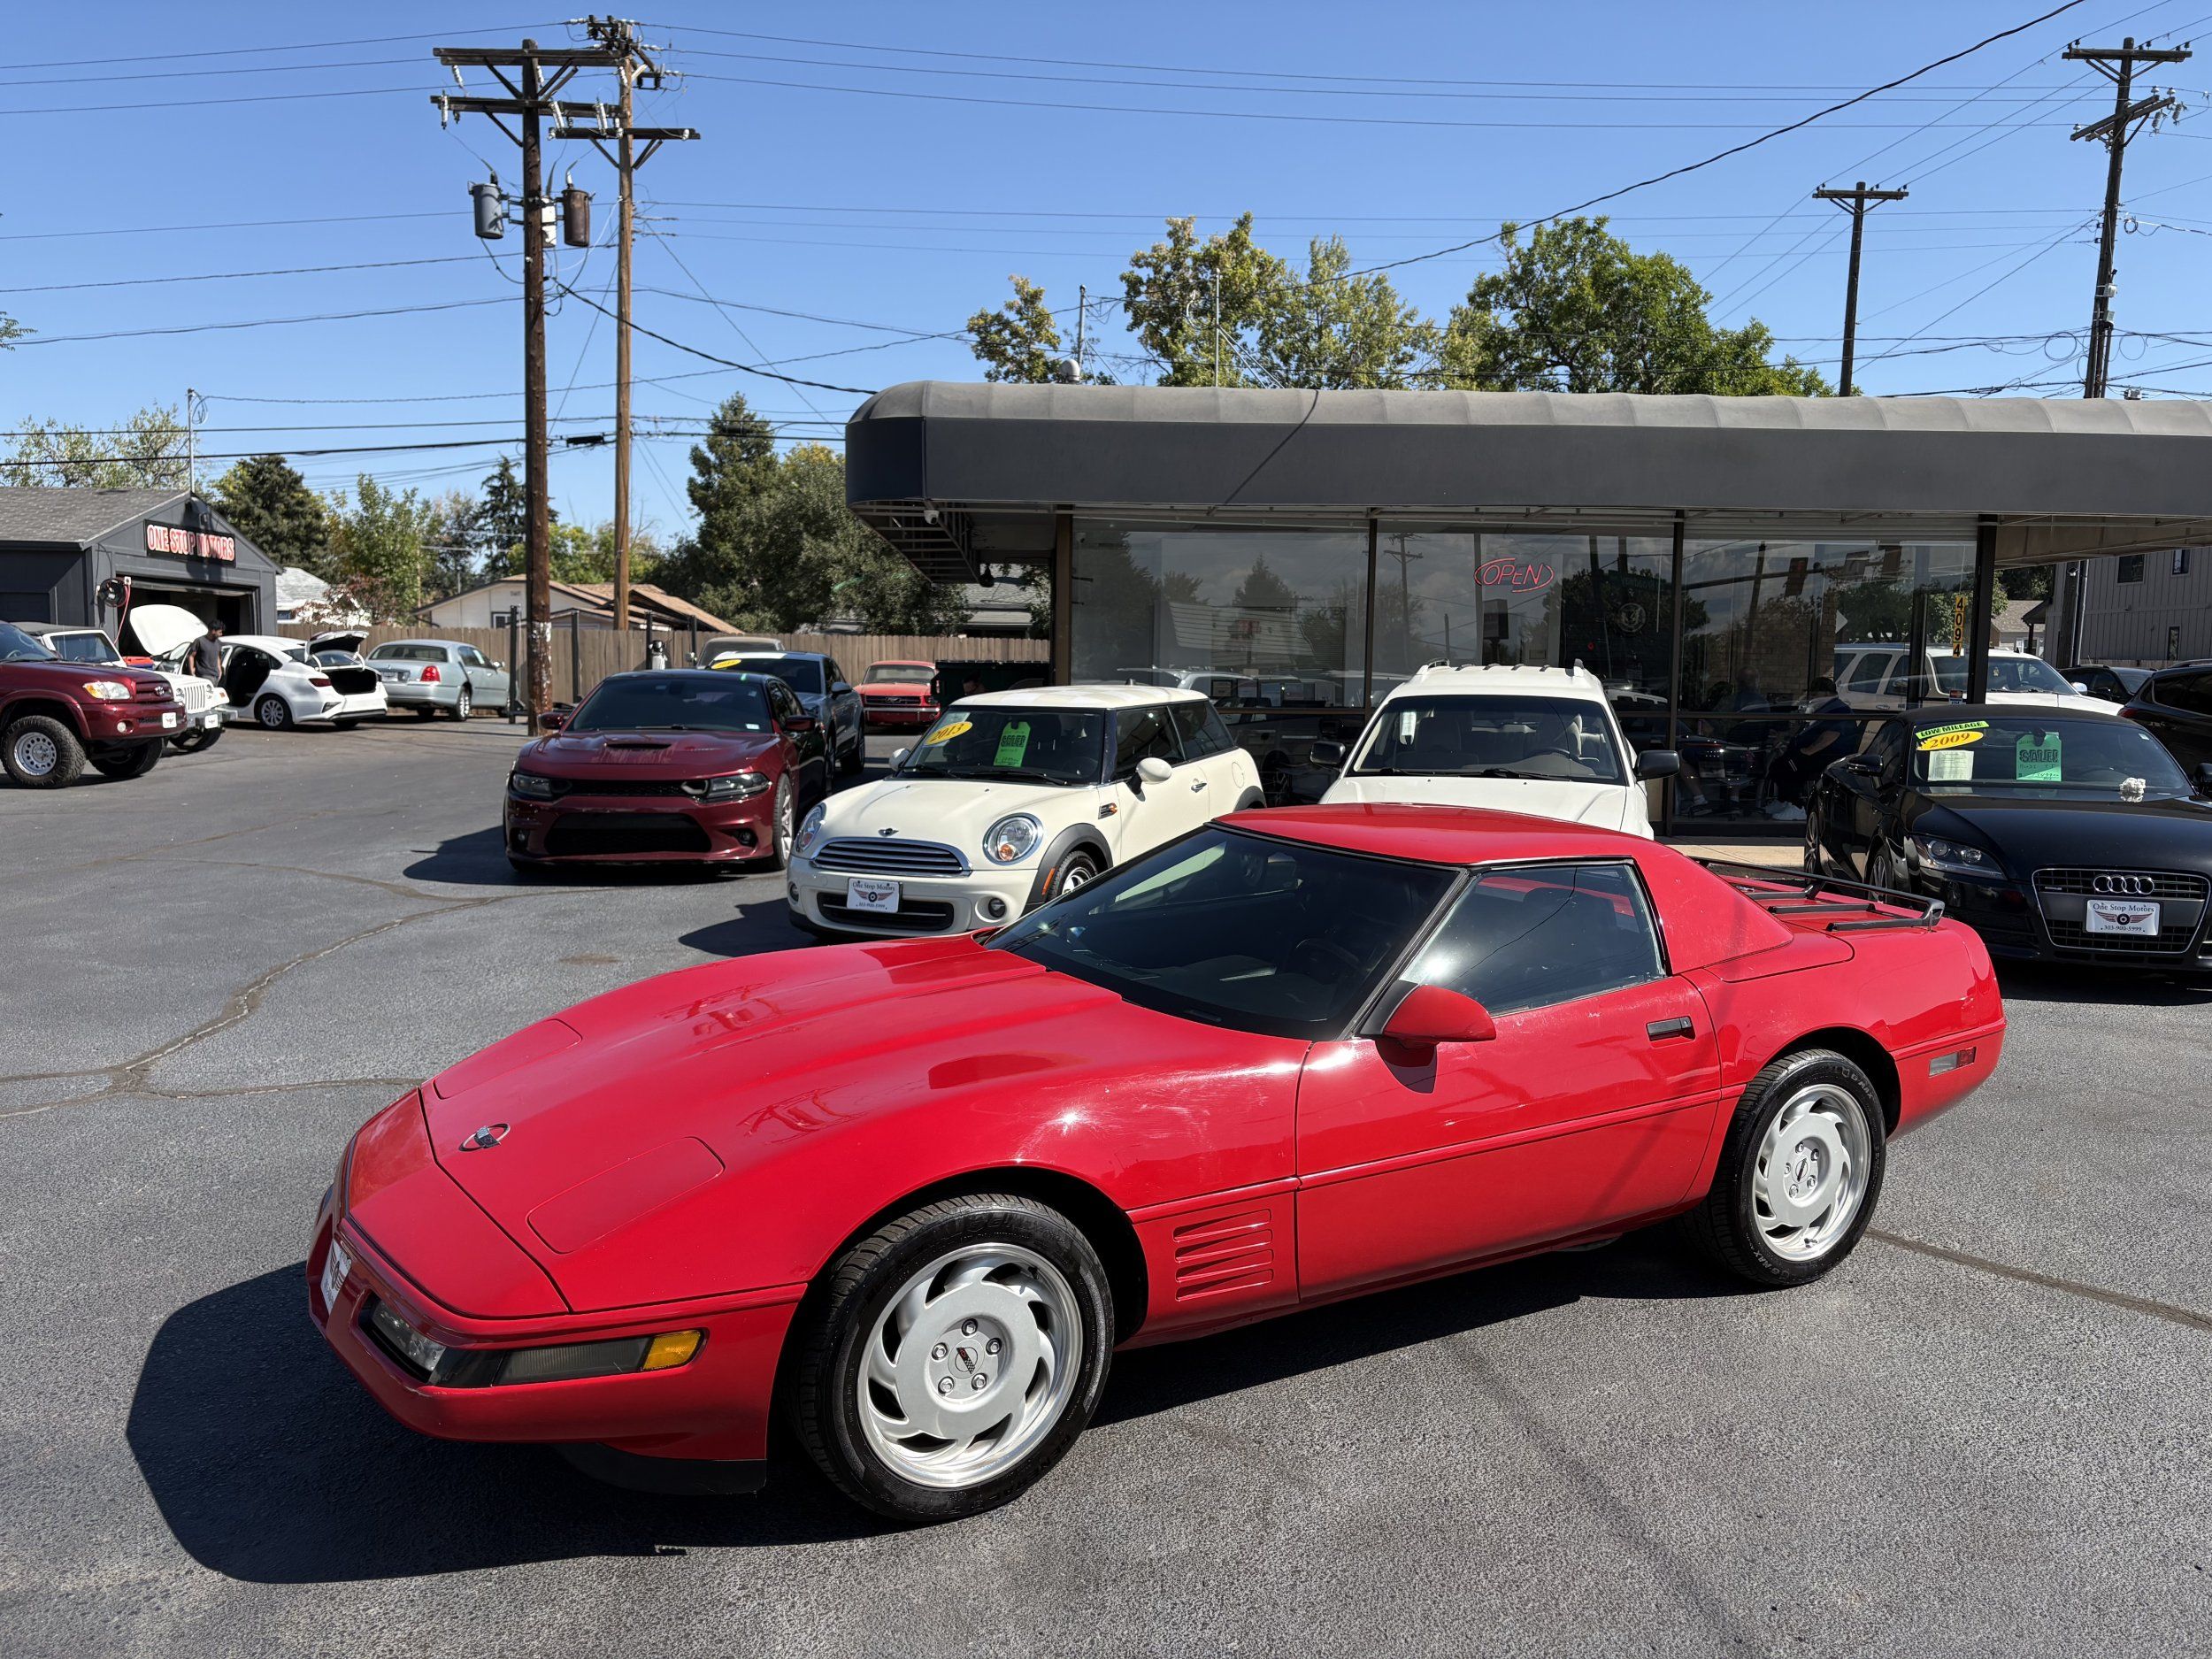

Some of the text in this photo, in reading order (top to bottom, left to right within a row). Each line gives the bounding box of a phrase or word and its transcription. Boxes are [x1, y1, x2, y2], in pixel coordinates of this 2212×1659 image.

[147, 524, 235, 561] ONE STOP MOTORS
[1483, 564, 1544, 585] OPEN
[1953, 597, 1963, 657] 4094
[929, 723, 964, 743] 2013
[1920, 721, 1984, 737] LOW MILEAGE
[1929, 732, 1970, 749] 2009
[2019, 749, 2059, 763] SALE!
[2109, 903, 2126, 912] Stop
